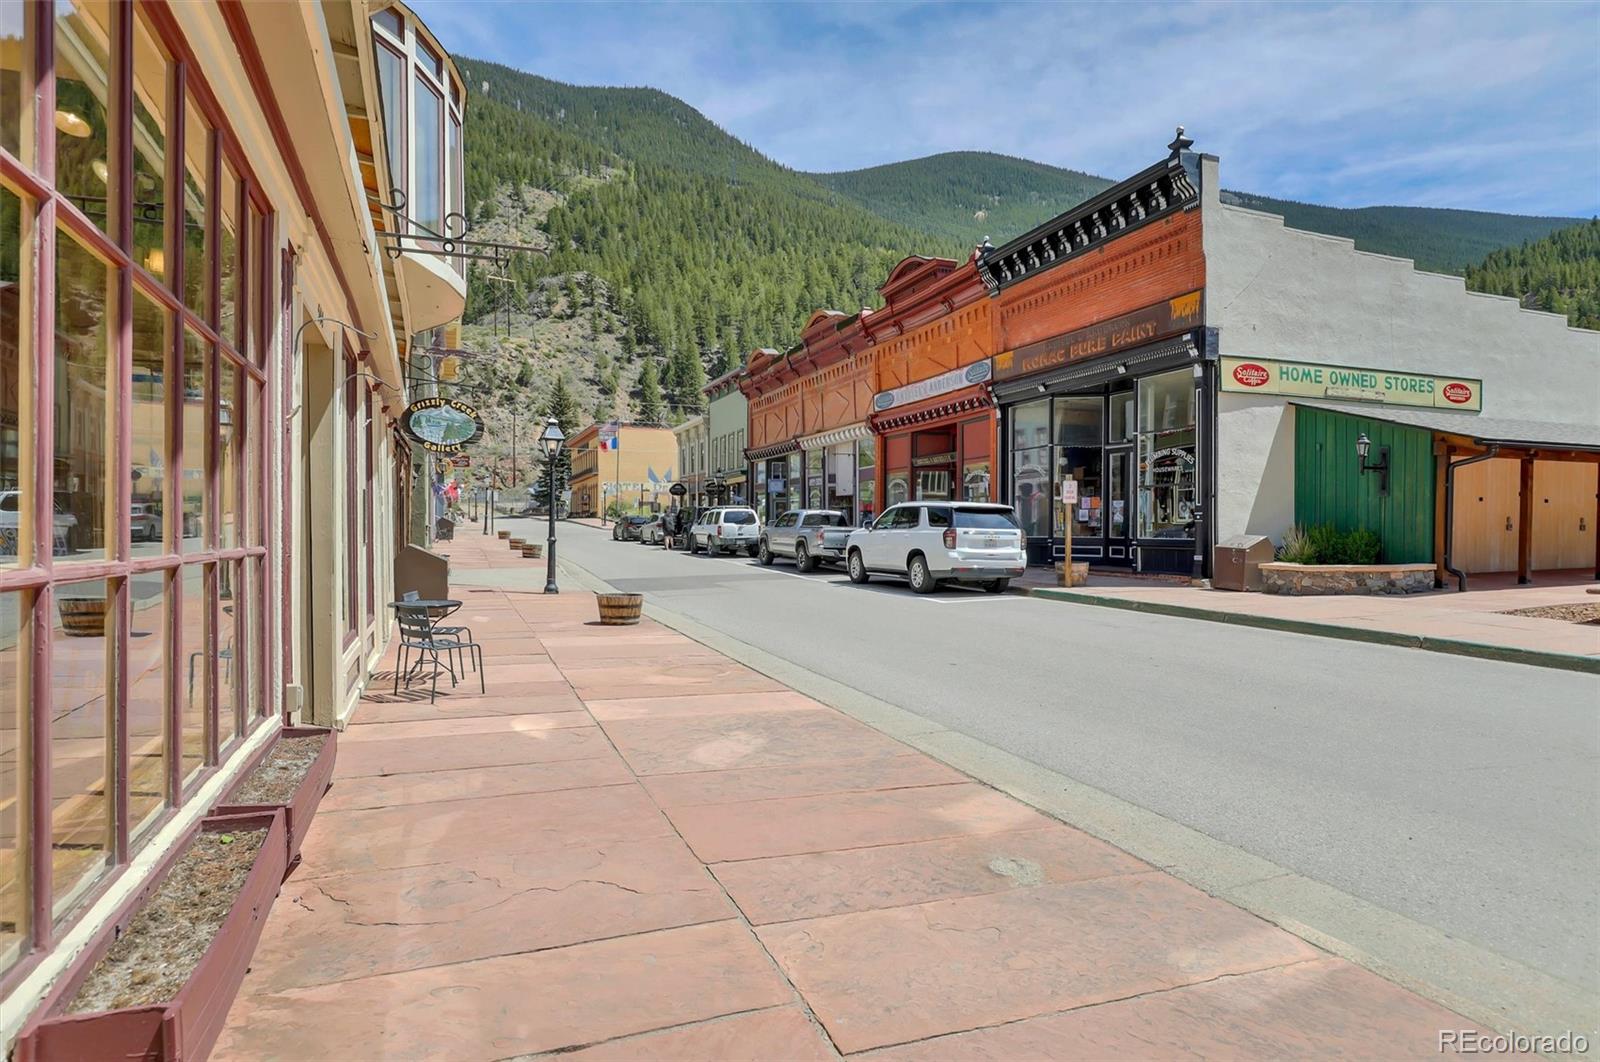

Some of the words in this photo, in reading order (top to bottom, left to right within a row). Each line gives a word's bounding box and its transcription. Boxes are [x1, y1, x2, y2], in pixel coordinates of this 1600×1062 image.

[1070, 337, 1106, 359] PURE
[1112, 322, 1157, 347] PAINT
[1236, 366, 1267, 379] Solitaire
[1279, 366, 1323, 384] HOME
[1329, 371, 1377, 388] OWNED
[1384, 376, 1434, 394] STORES
[410, 398, 445, 412] Grizzly
[451, 400, 477, 419] Creek
[423, 441, 462, 452] Gallery
[1171, 447, 1195, 464] SUPPLIES
